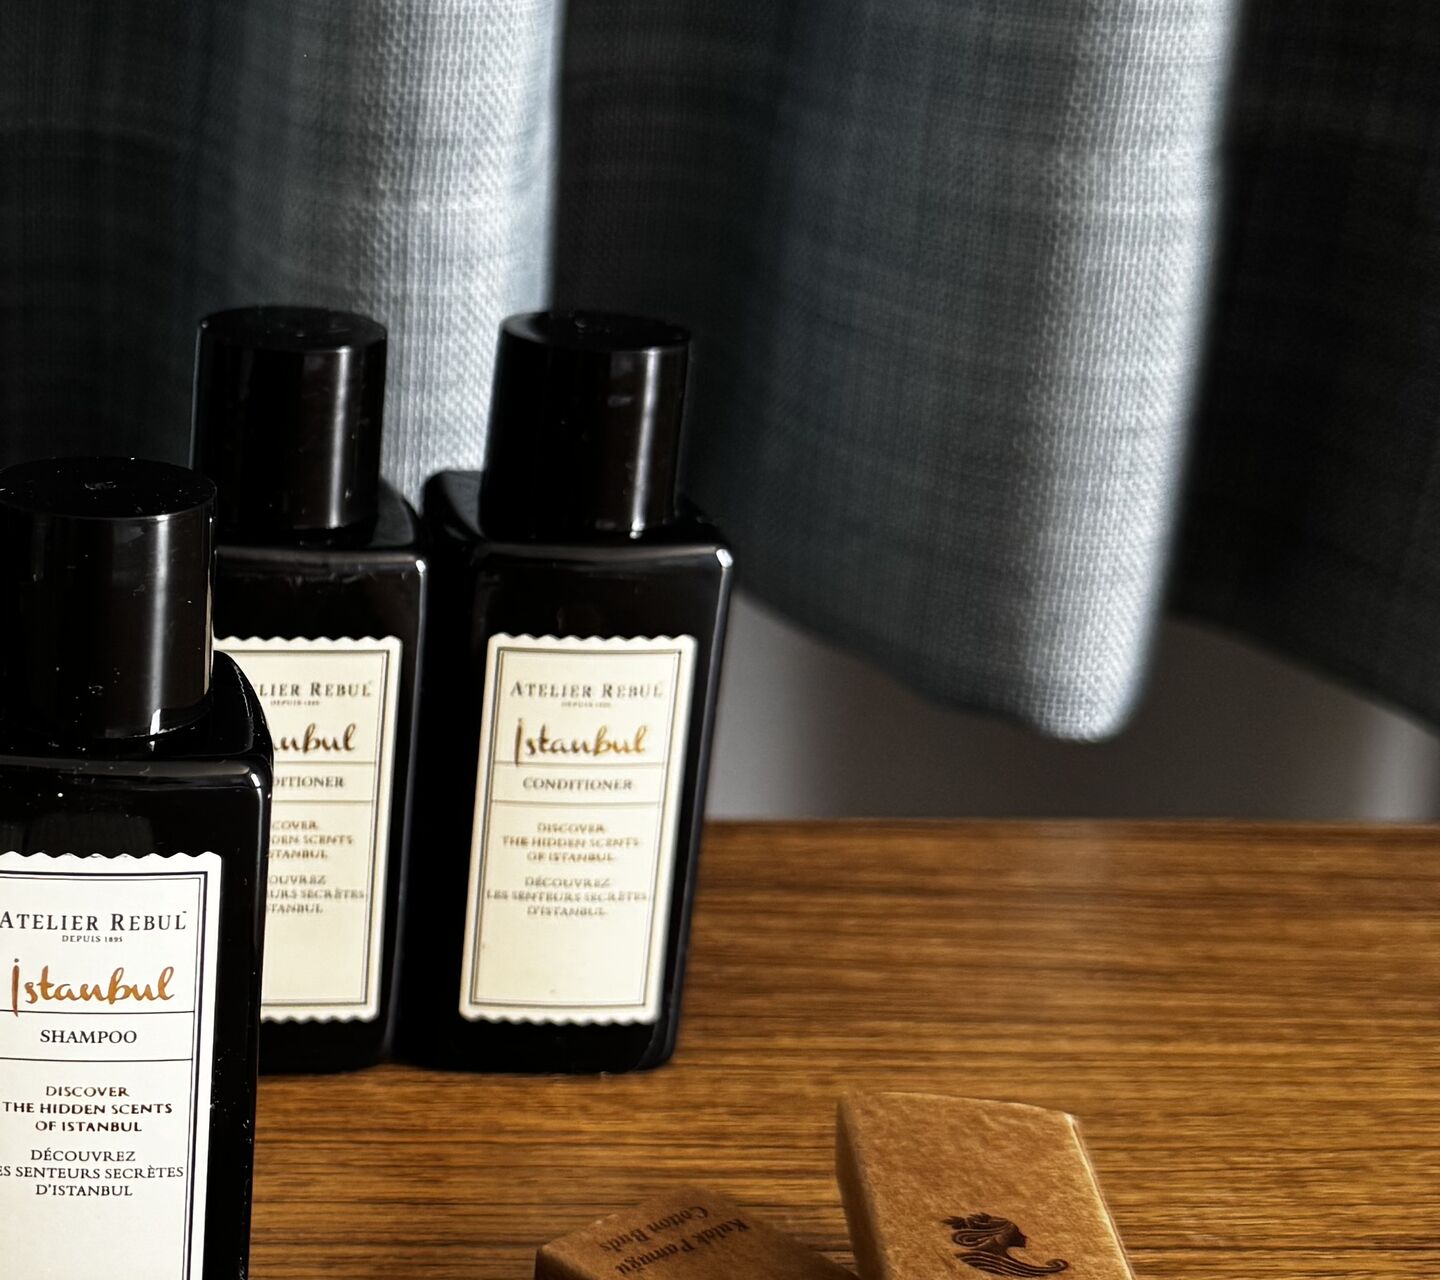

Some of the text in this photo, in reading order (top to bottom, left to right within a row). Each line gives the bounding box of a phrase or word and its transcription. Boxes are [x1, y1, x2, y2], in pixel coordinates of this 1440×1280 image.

[259, 681, 372, 698] LIER REBUL
[510, 680, 664, 699] ATELIER REBUL
[273, 722, 357, 754] nbul
[272, 775, 345, 788] DITIONER
[522, 776, 633, 791] CONDITIONER
[271, 820, 319, 831] COVER
[269, 874, 327, 886] OUVREZ
[110, 913, 187, 931] REBUL
[61, 934, 102, 943] DEPUIS
[39, 1029, 138, 1045] SHAMPOO
[45, 1085, 130, 1098] DISCOVER
[2, 1100, 173, 1115] THE HIDDEN SCENTS
[34, 1120, 143, 1133] OF ISTANBUL
[30, 1147, 136, 1163] DÉCOUVREZ
[15, 1166, 101, 1180] SENTEURS
[104, 1164, 184, 1179] SECRÈTES
[35, 1183, 134, 1197] D'ISTANBUL
[599, 1205, 709, 1253] Cotton Buds
